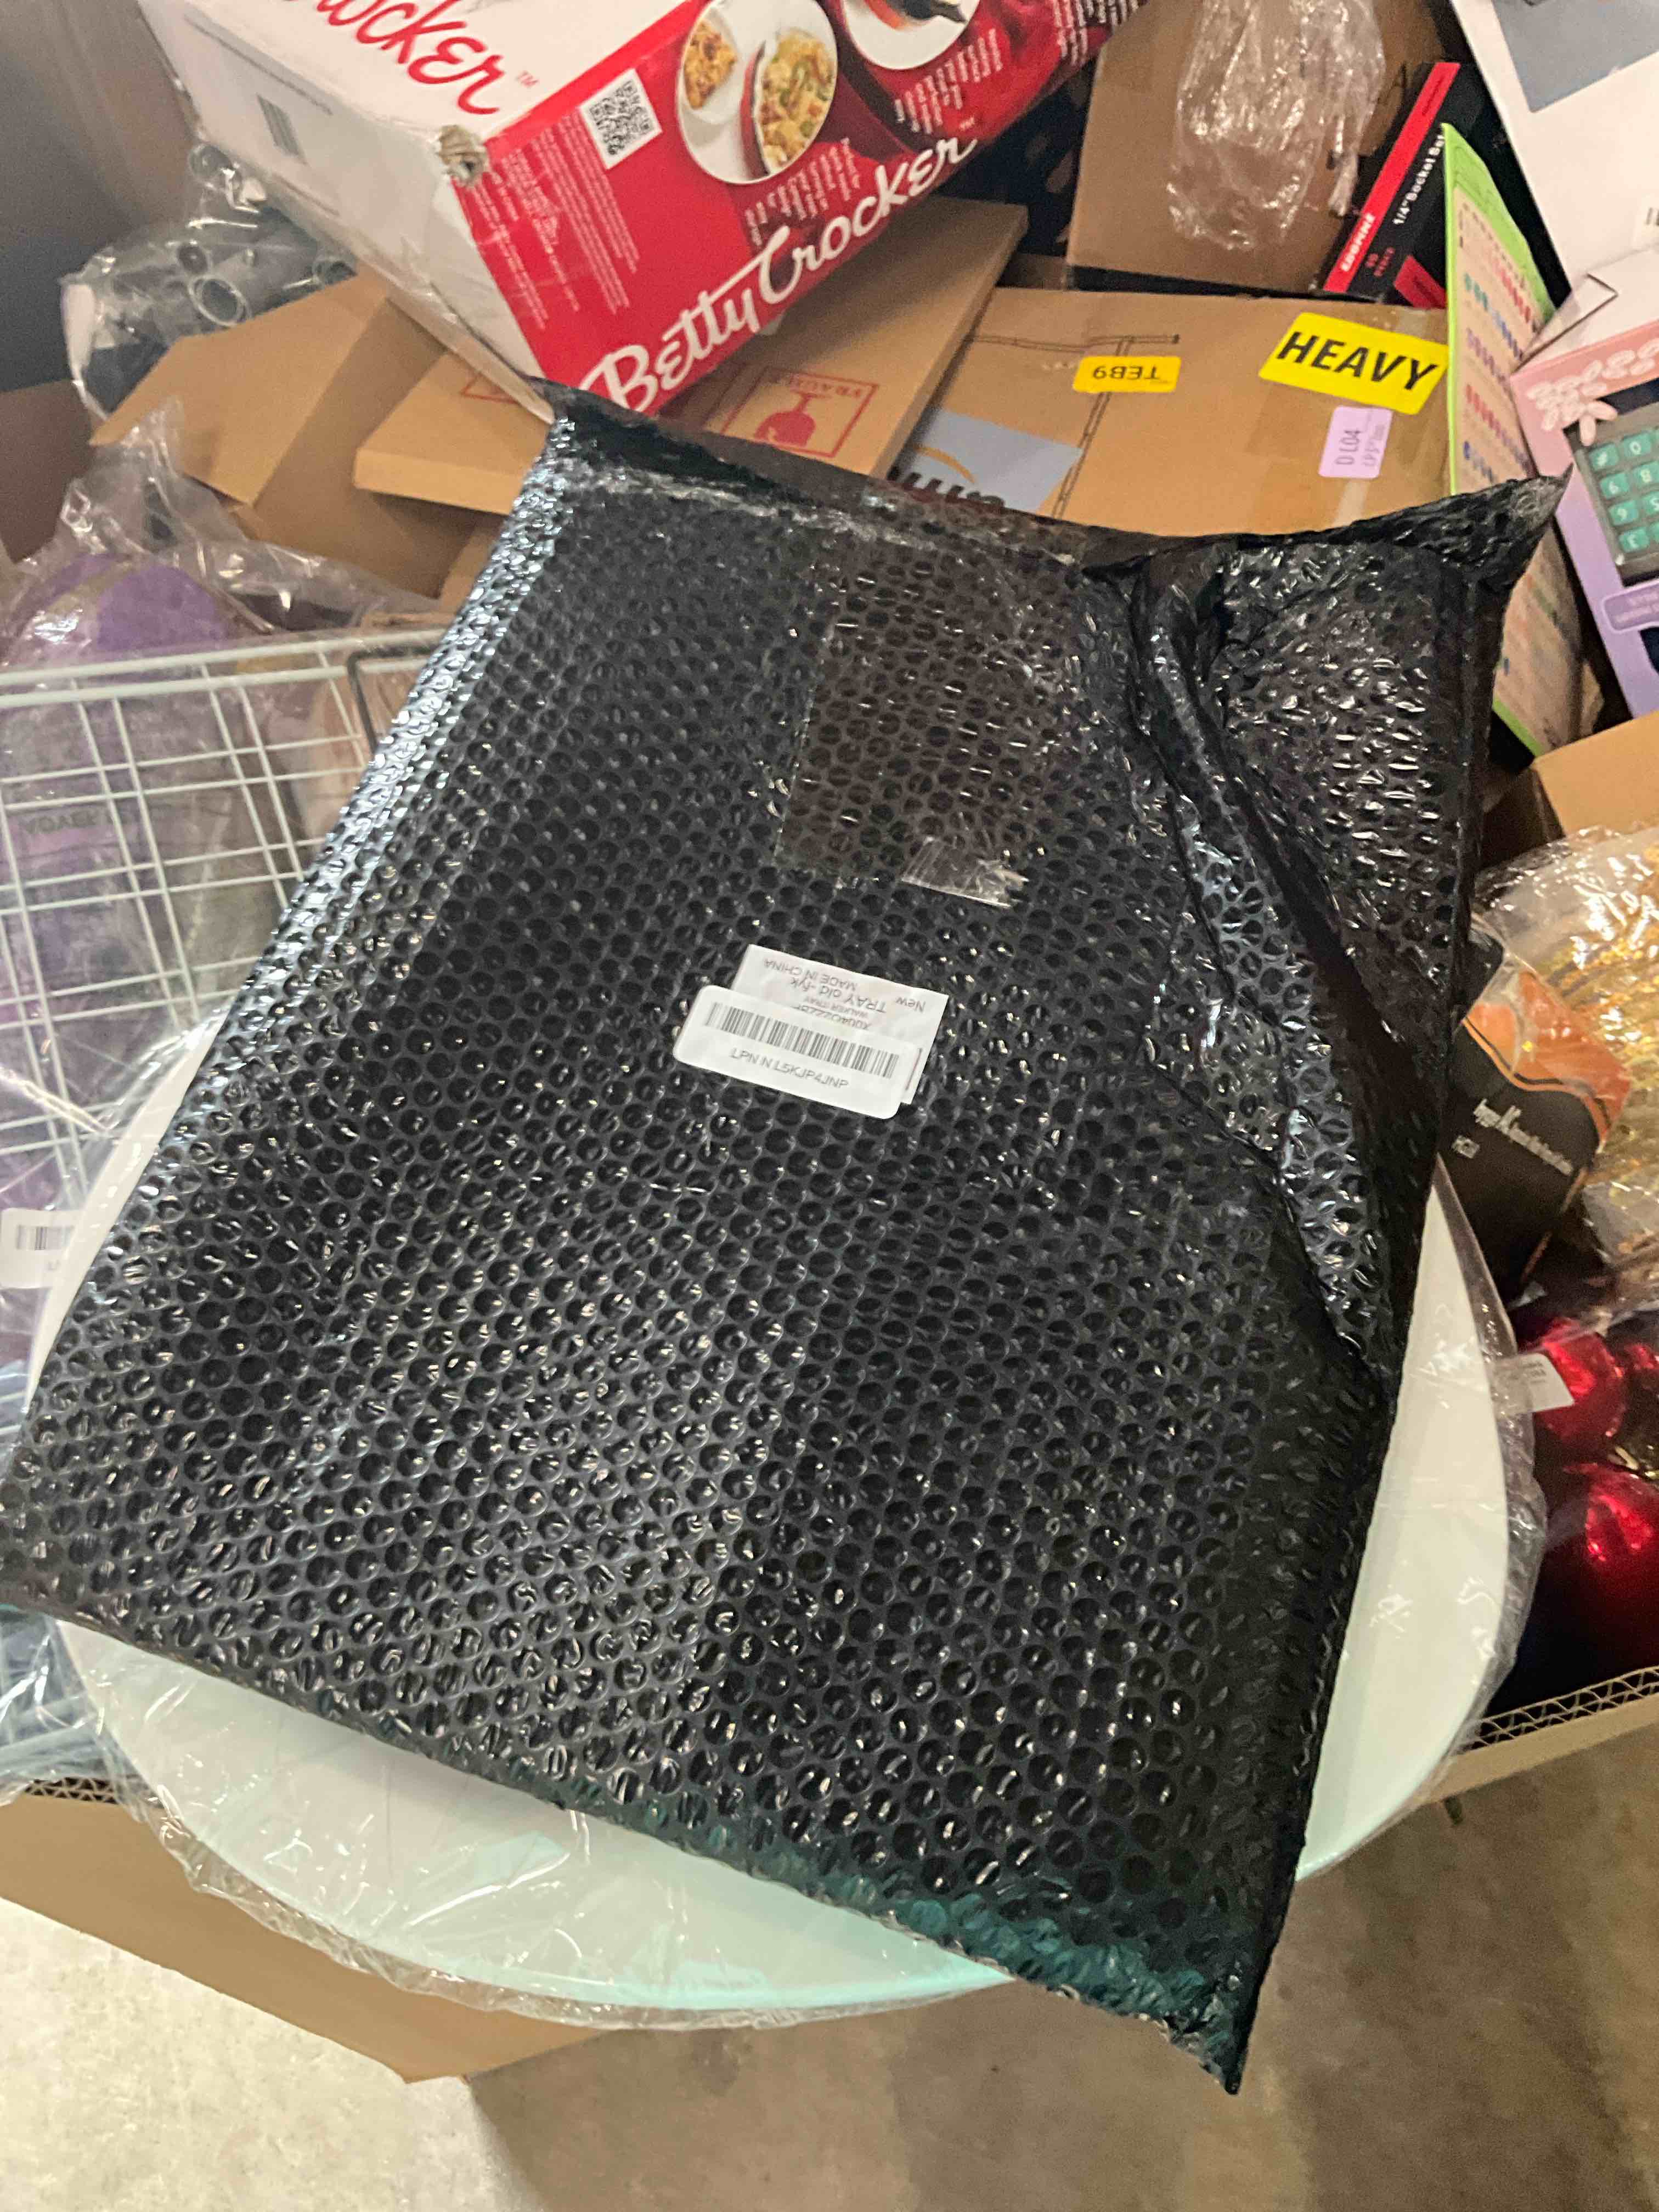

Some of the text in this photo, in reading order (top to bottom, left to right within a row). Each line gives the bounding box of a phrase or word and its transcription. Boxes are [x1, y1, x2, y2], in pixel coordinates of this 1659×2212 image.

[316, 0, 504, 115] ocker
[582, 290, 760, 411] Betty
[759, 137, 979, 304] Crocker
[1092, 366, 1159, 380] TEB9
[1276, 331, 1438, 391] HEAVY
[764, 958, 858, 991] MADE IN CHINA
[844, 993, 887, 1013] TRAY
[895, 996, 926, 1013] New
